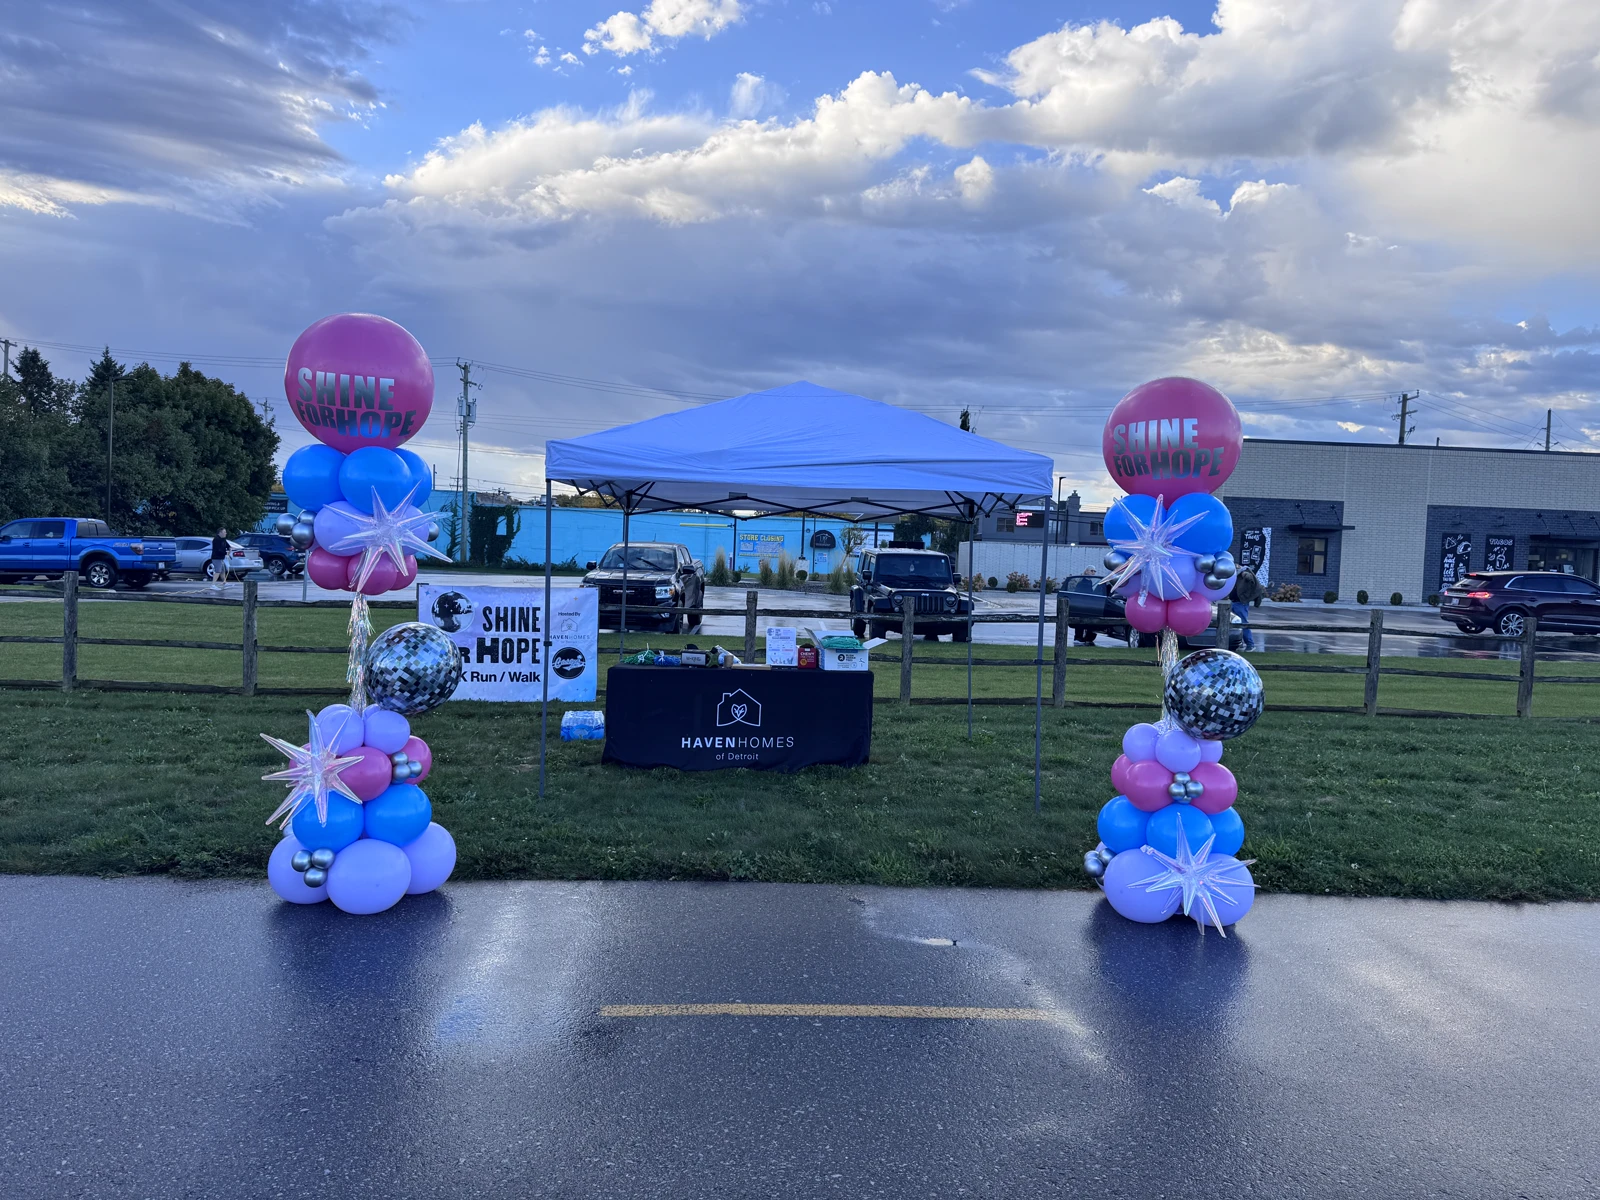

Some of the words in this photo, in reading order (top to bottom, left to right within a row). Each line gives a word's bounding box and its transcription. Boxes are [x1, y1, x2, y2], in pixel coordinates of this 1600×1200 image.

[297, 367, 395, 411] SHINE
[296, 399, 337, 428] FOR
[335, 408, 417, 438] HOPE
[1113, 417, 1199, 455] SHINE
[1113, 453, 1151, 477] FOR
[1149, 446, 1225, 480] HOPE
[482, 605, 541, 633] SHINE
[476, 637, 541, 664] HOPE
[470, 671, 497, 683] Run
[509, 671, 541, 683] Walk
[681, 736, 795, 748] HAVENHOMES
[715, 753, 725, 761] of
[727, 753, 759, 761] Detroit
